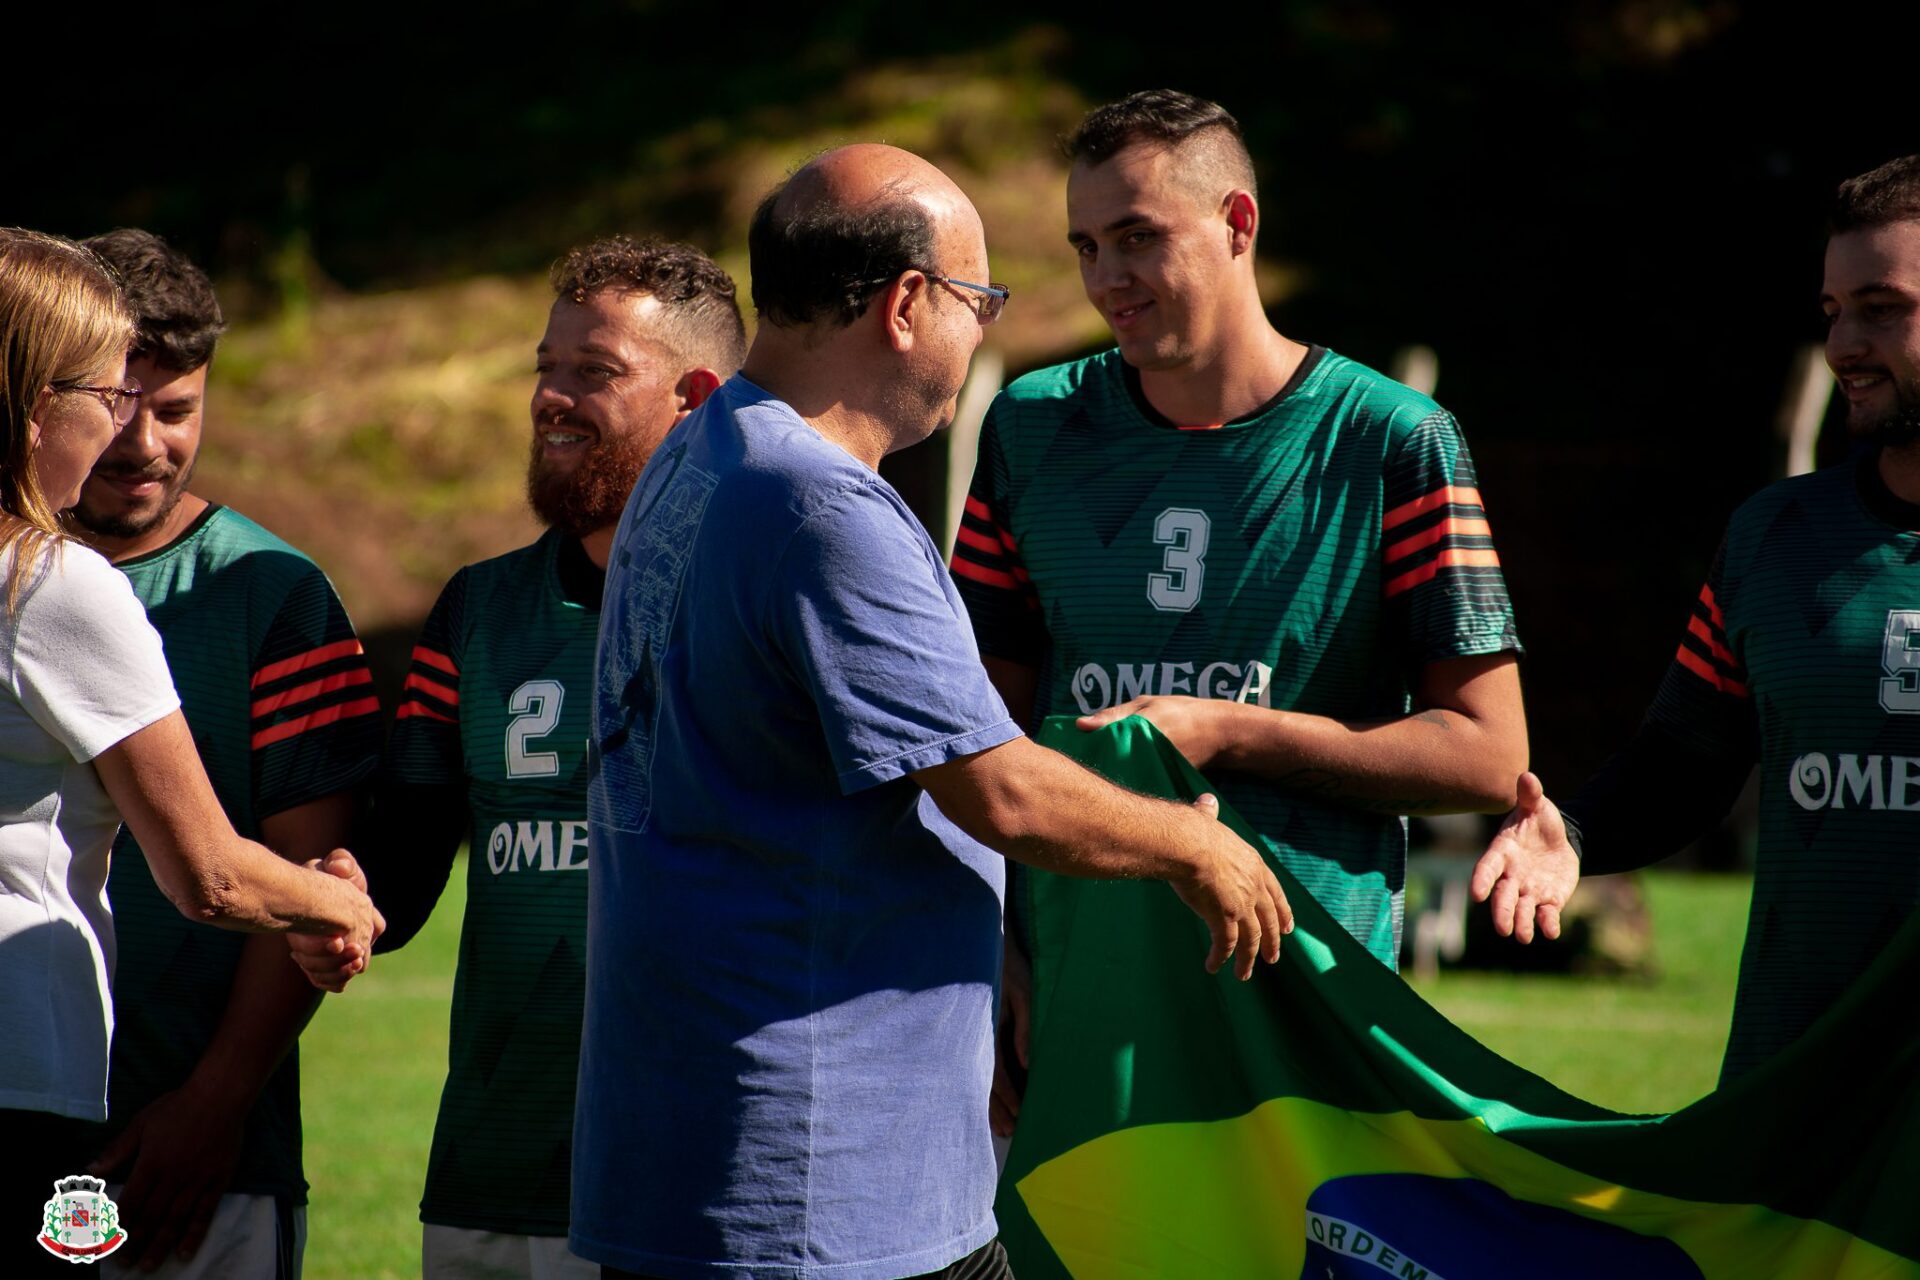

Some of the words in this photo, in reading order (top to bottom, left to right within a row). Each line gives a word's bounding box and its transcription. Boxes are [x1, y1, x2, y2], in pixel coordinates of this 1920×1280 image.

[1146, 507, 1211, 613] 3
[1071, 659, 1273, 715] OMEGA
[1878, 609, 1920, 715] 5
[506, 679, 565, 779] 2
[1789, 751, 1920, 812] OME
[487, 820, 589, 875] OME
[1311, 1216, 1428, 1280] ORDEM
